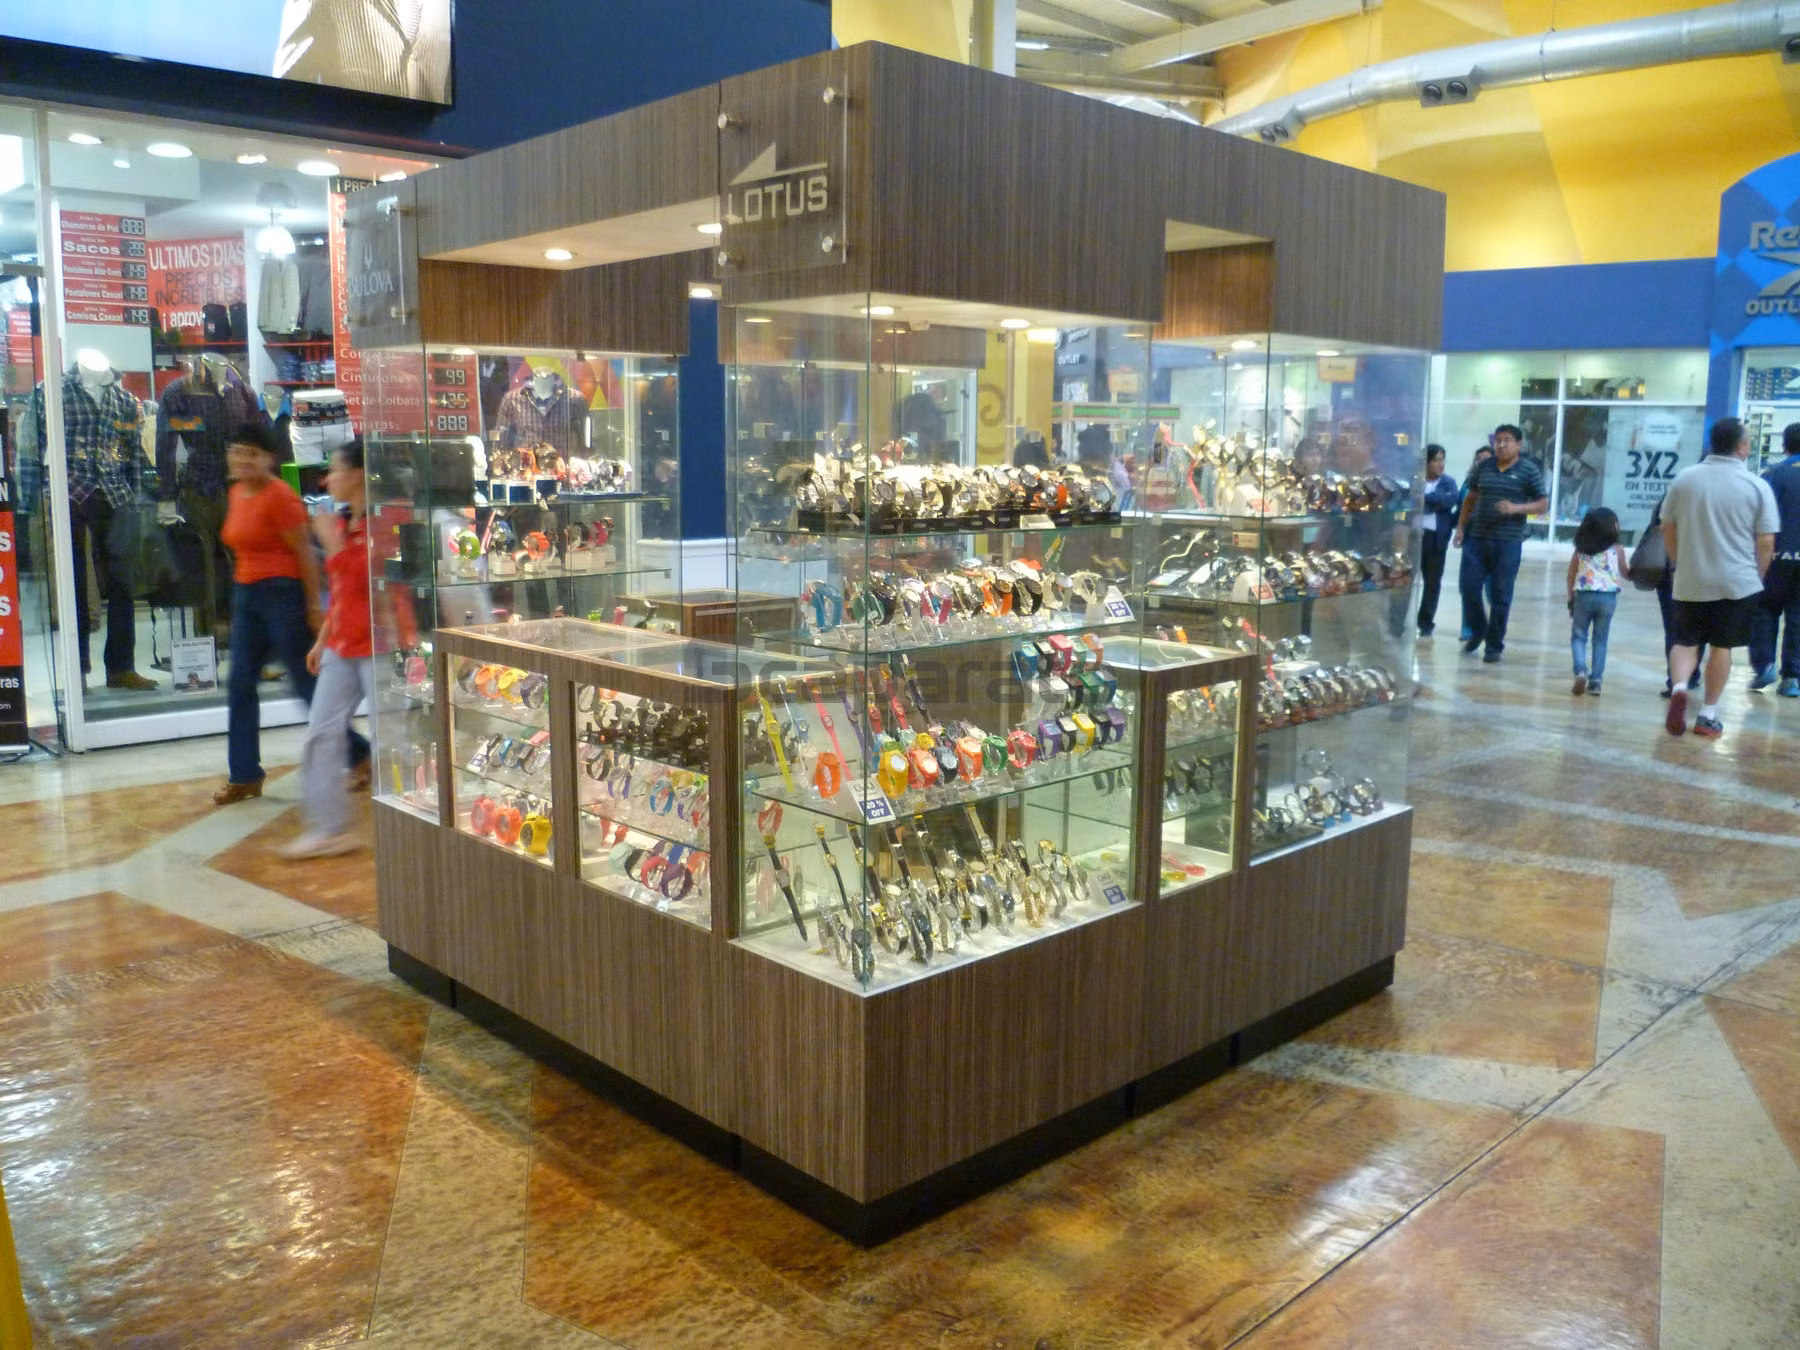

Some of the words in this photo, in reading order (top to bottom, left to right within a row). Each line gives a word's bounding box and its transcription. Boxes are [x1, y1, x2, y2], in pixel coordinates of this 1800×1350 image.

[726, 175, 828, 225] LOTUS
[63, 240, 121, 256] Sacos
[148, 244, 210, 271] ULTIMOS
[164, 269, 233, 290] PRECIOS
[348, 270, 394, 298] BULOVA
[1058, 353, 1081, 366] OUTLET
[446, 369, 465, 385] 99
[1625, 450, 1679, 480] 3X2
[871, 808, 886, 818] OFF
